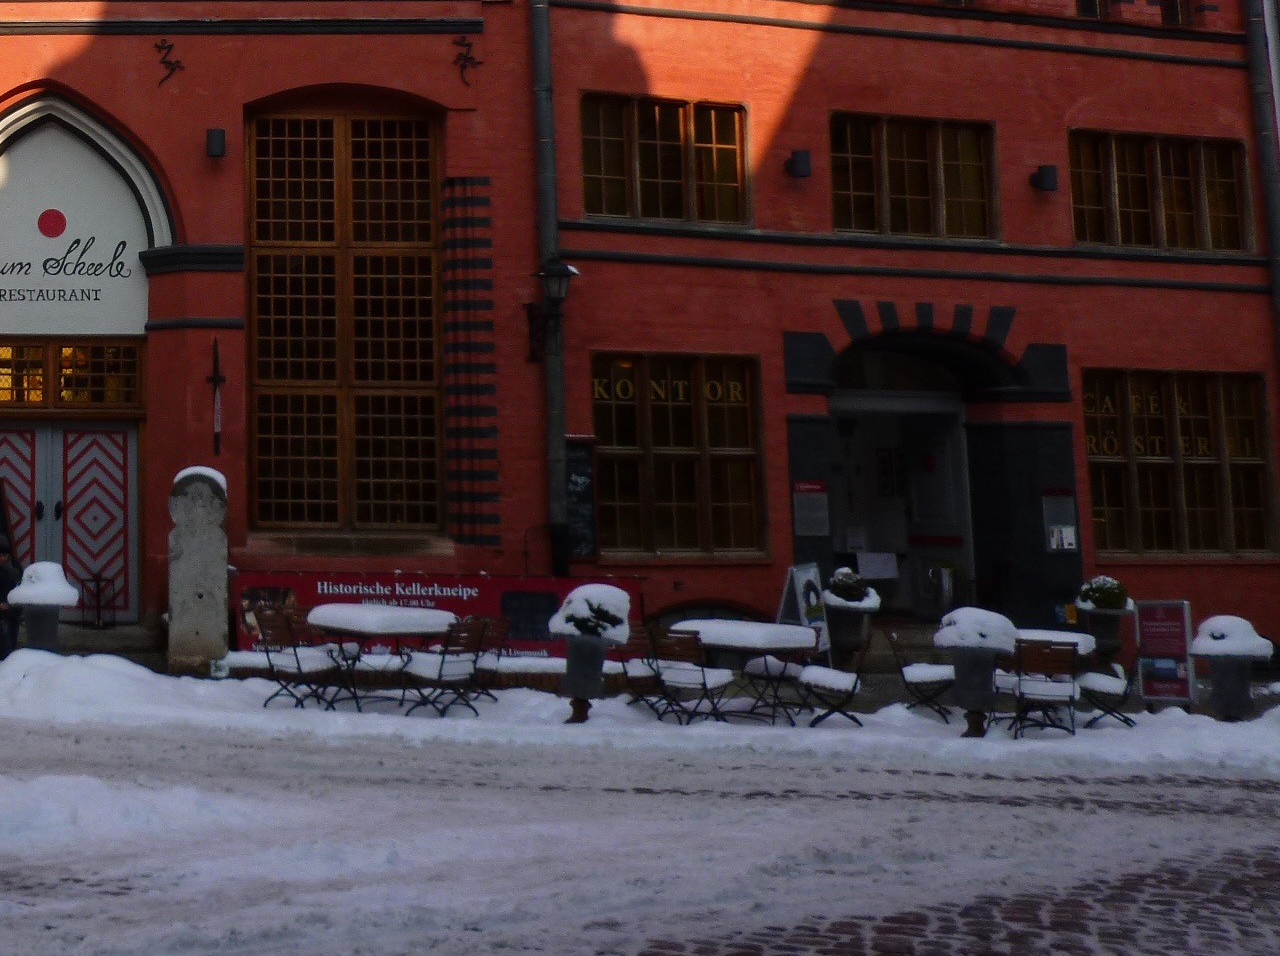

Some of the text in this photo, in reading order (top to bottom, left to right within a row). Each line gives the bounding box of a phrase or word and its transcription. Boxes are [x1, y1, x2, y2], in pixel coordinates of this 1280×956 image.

[43, 236, 132, 278] Scheele
[0, 288, 102, 302] RESTAURANT
[1083, 389, 1162, 415] CAFÉ
[316, 581, 480, 600] Historische Kellerkneipe
